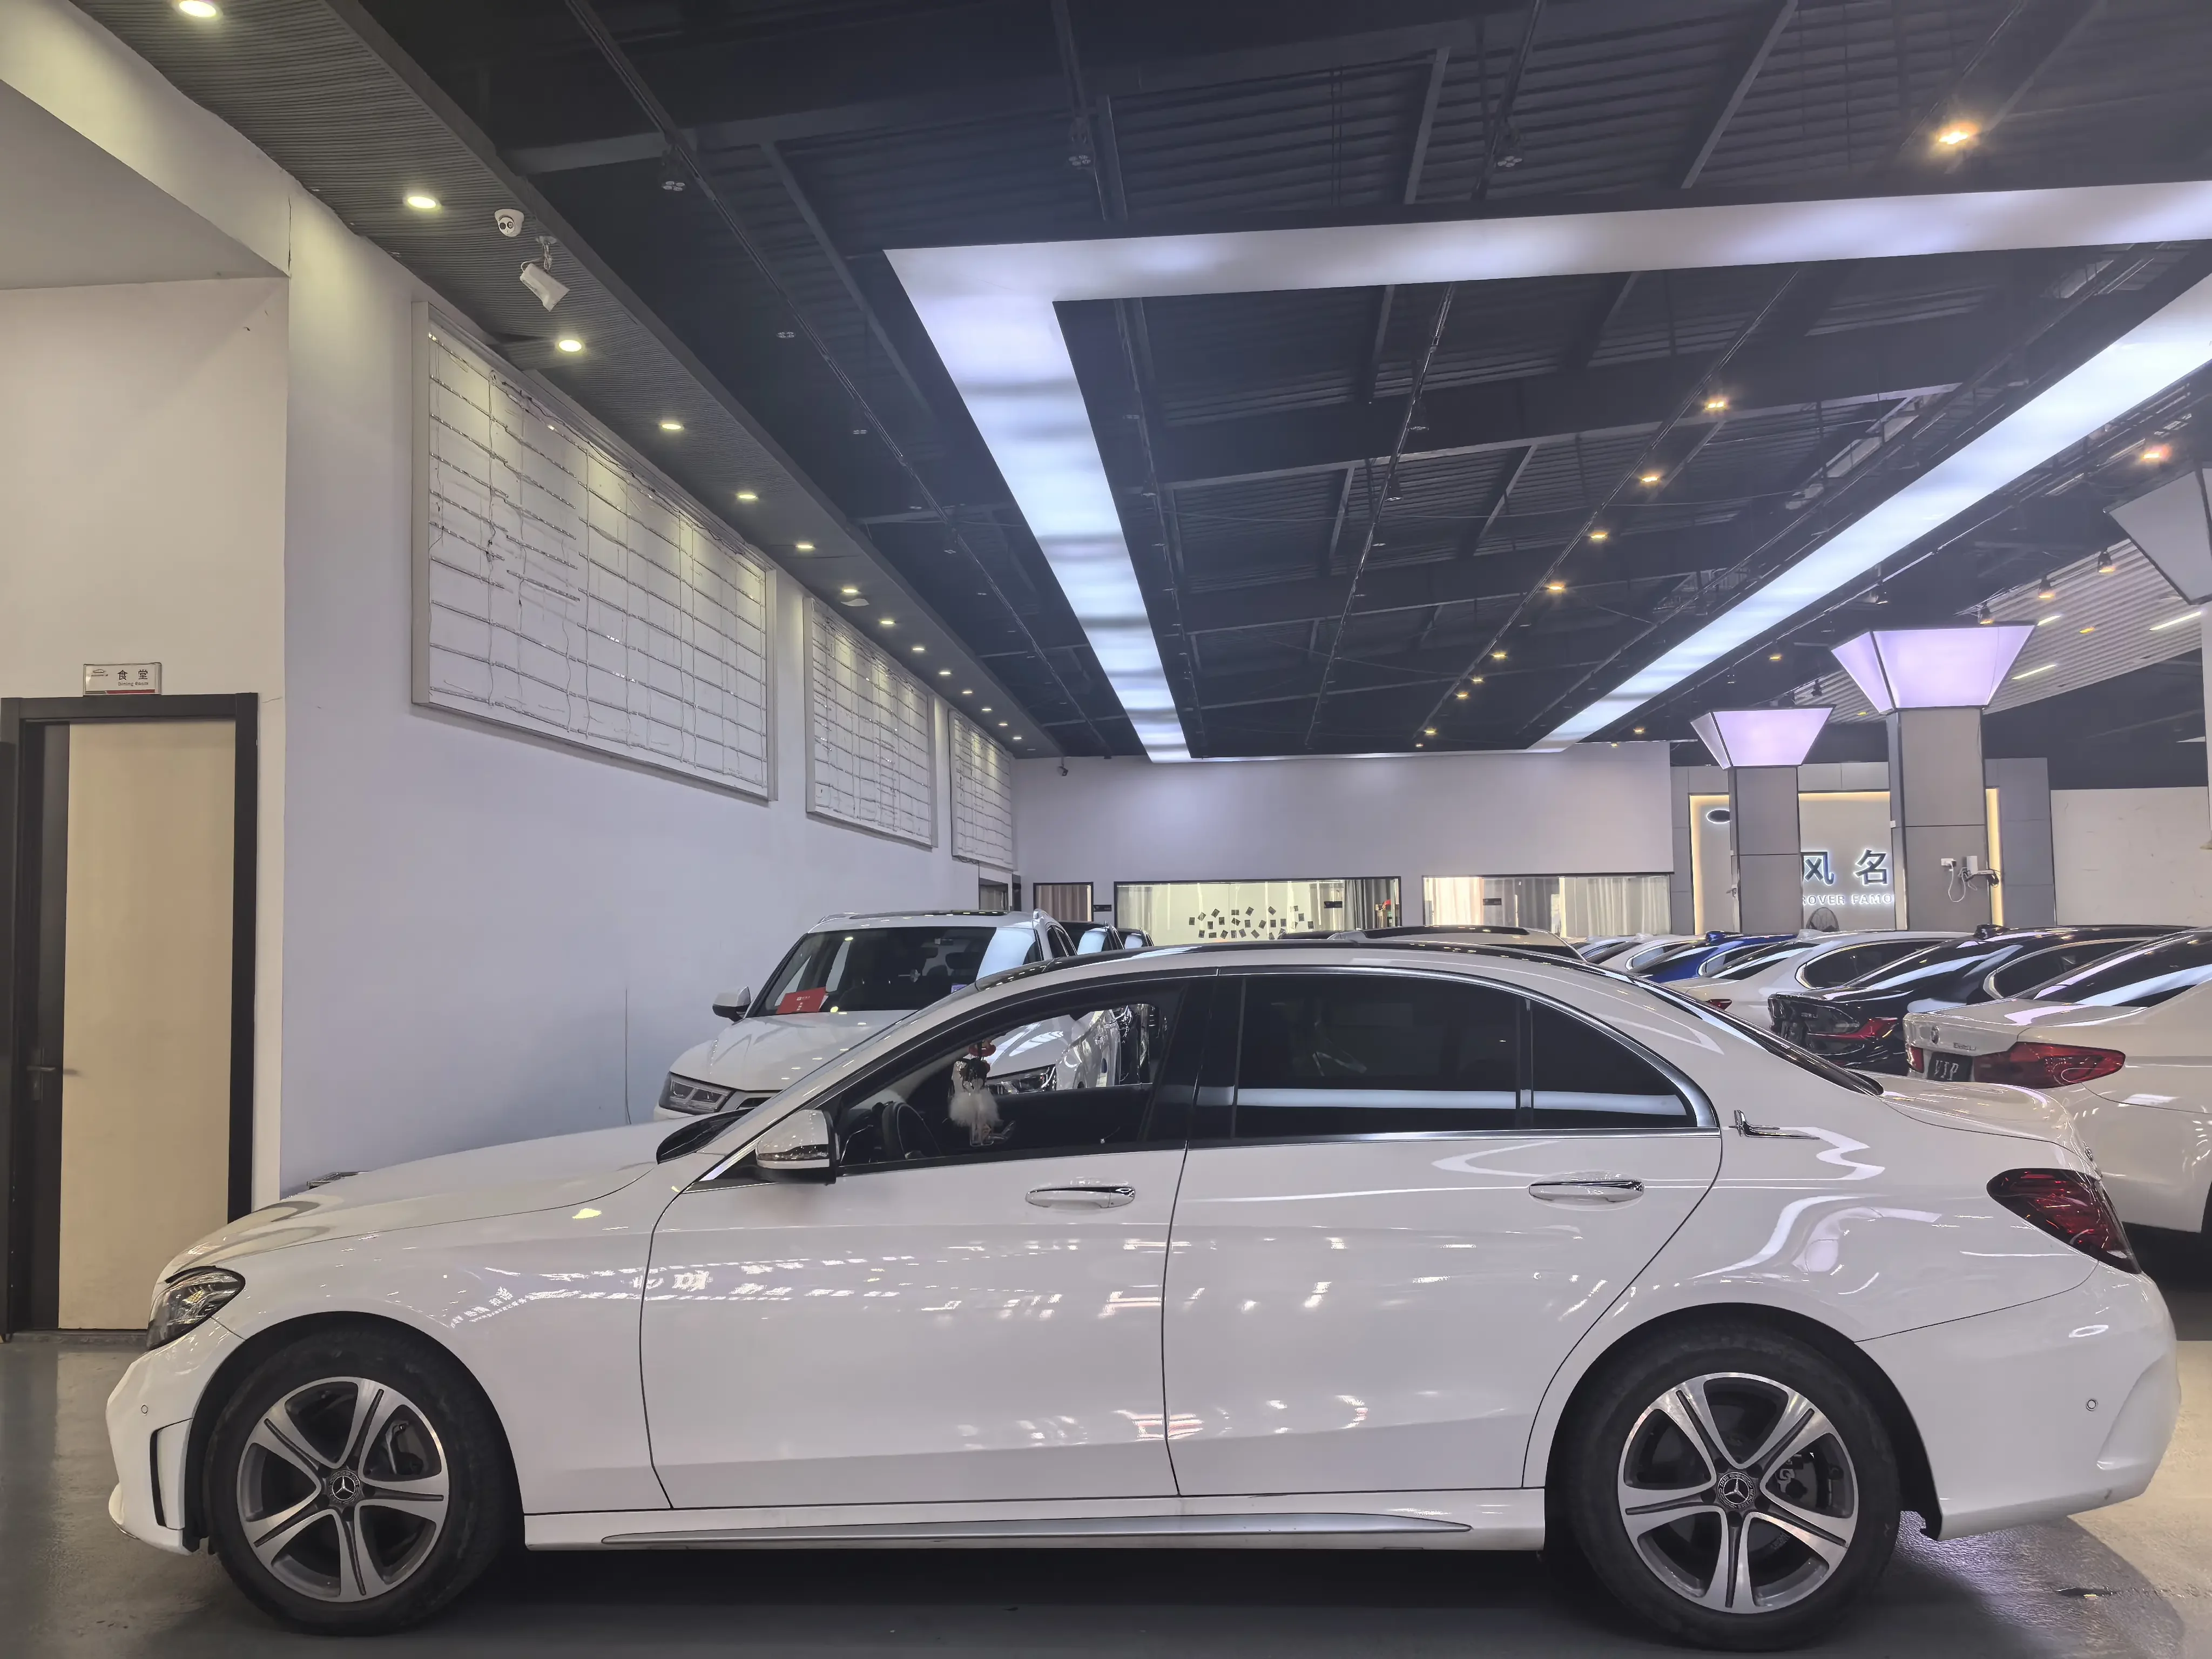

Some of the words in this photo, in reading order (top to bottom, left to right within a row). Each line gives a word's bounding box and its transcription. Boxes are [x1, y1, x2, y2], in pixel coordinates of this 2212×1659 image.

[117, 670, 148, 680] 食堂
[1801, 849, 1888, 885] 风名
[1851, 894, 1894, 905] FAMO
[1934, 1060, 1959, 1080] VIP
